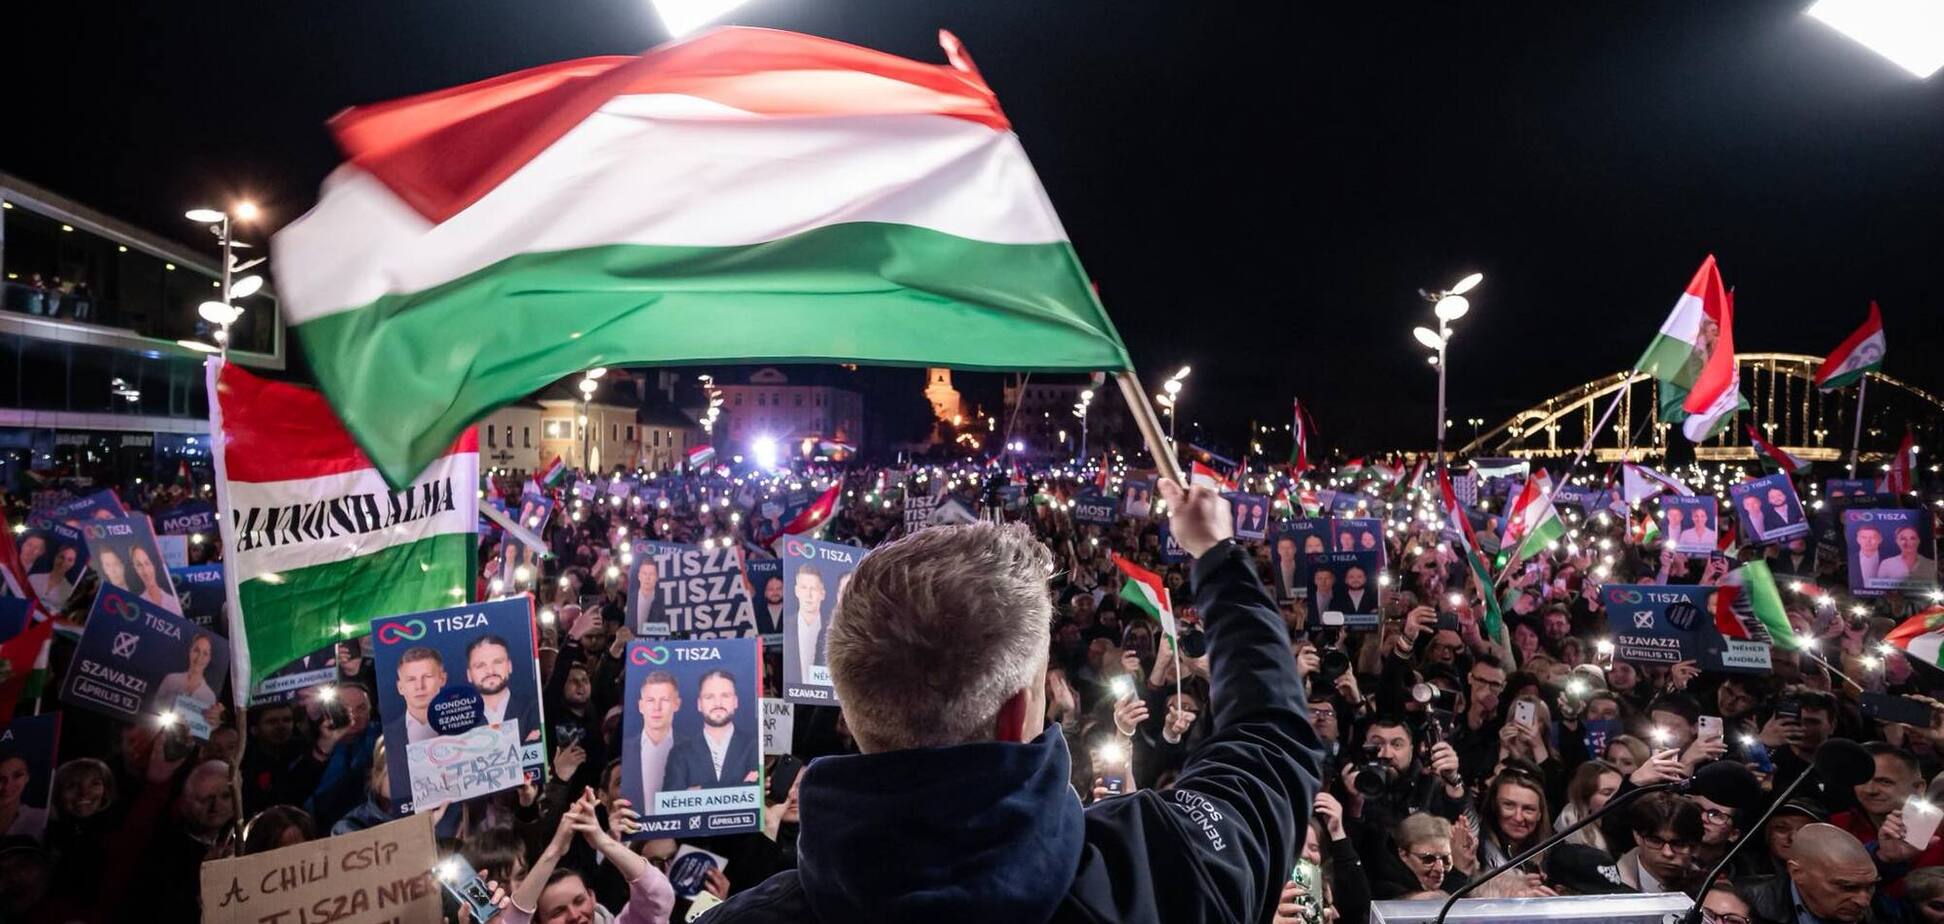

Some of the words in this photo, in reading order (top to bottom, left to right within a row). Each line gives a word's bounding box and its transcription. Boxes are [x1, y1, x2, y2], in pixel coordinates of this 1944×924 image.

[1076, 504, 1112, 517] MOST
[1876, 512, 1908, 521] TISZA
[163, 512, 210, 531] MOST
[106, 524, 133, 536] TISZA
[653, 544, 741, 579] TISZA
[819, 547, 853, 564] TISZA
[1332, 553, 1357, 562] TISZA
[753, 562, 777, 571] TISZA
[186, 568, 221, 583] TISZA
[659, 574, 748, 606] TISZA
[1647, 592, 1692, 604] TISZA
[434, 612, 489, 633] TISZA
[665, 601, 755, 632] TISZA
[145, 612, 182, 640] TISZA
[1619, 634, 1681, 648] SZAVAZZ!
[675, 647, 721, 661] TISZA
[80, 659, 148, 693] SZAVAZZ!
[788, 688, 829, 699] SZAVAZZ!
[434, 696, 477, 712] GONDOLJ
[438, 710, 476, 726] SZAVAZZ
[661, 794, 702, 808] NÉHER
[705, 792, 756, 806] ANDRÁS
[1175, 789, 1223, 822] SQUAD
[219, 877, 250, 908] A
